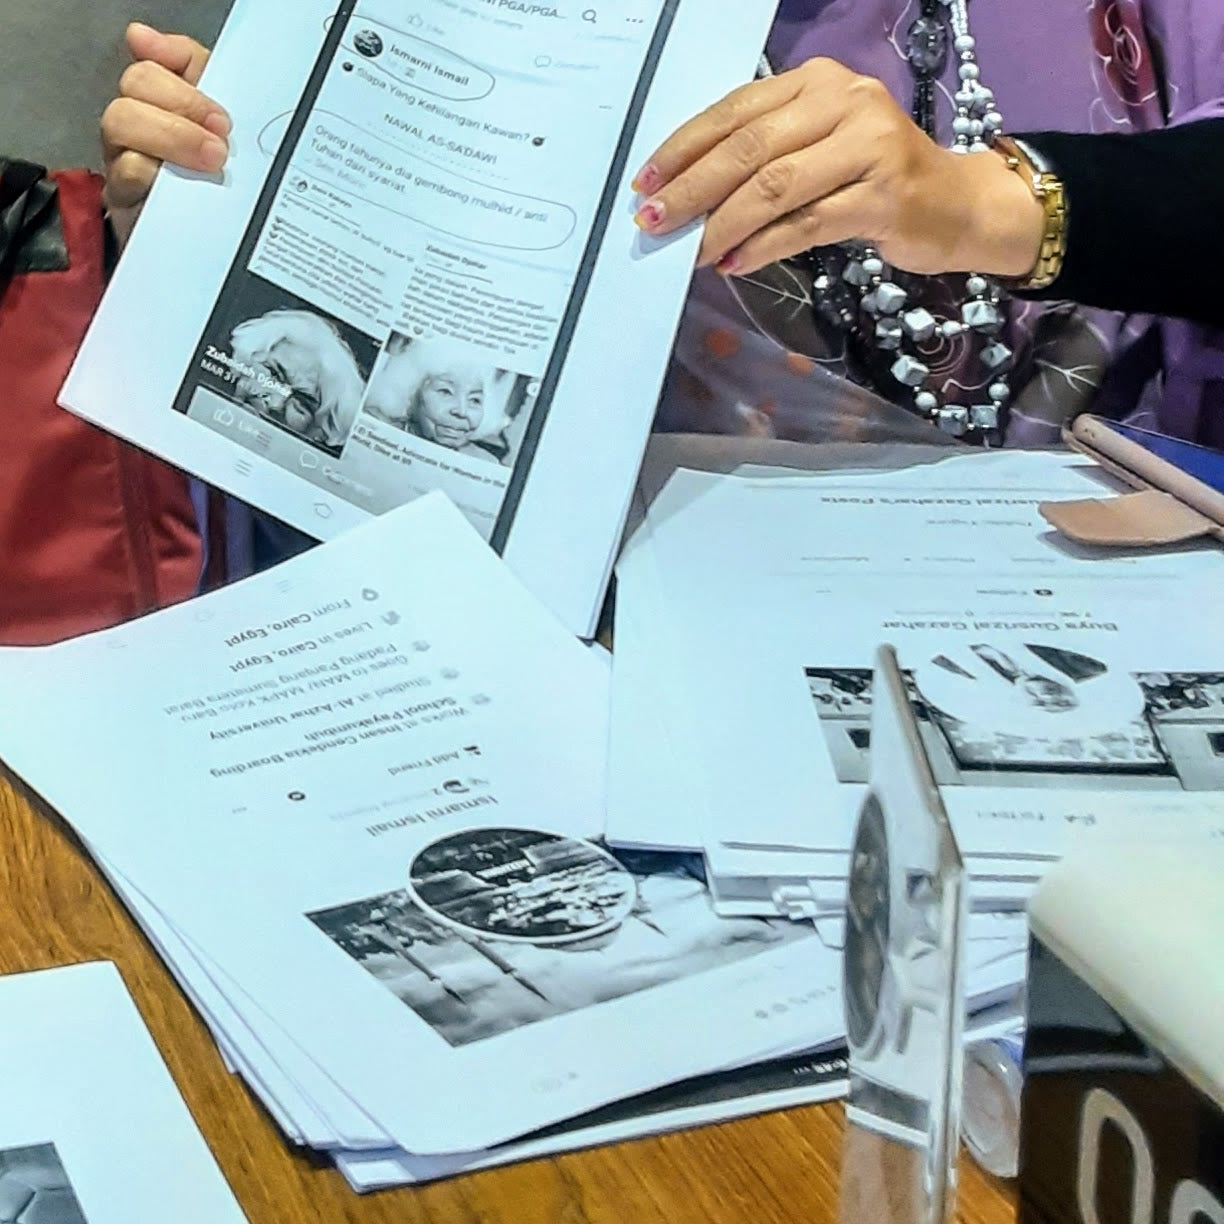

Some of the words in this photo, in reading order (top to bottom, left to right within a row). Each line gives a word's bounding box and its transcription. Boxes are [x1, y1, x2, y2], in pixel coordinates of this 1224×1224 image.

[433, 62, 470, 87] Ismail
[389, 83, 416, 106] Yang
[417, 97, 481, 129] Kehilangan
[483, 122, 530, 142] Kawan?
[384, 113, 424, 138] NAWAL
[311, 139, 343, 162] Tuhan
[315, 124, 348, 149] Orang
[395, 163, 412, 180] dia
[414, 176, 470, 204] gembong
[312, 599, 352, 618] From
[267, 613, 312, 632] Cairo,
[336, 621, 373, 640] Lives
[224, 630, 269, 648] Egypt
[272, 640, 318, 658] Cairo,
[318, 633, 335, 645] in
[229, 655, 274, 673] Egypt
[340, 643, 398, 666] Padang
[374, 677, 432, 700] Studied
[408, 696, 457, 716] School
[209, 715, 288, 742] University
[304, 711, 406, 741] Payakumbuh
[361, 724, 403, 741] Insan
[285, 735, 358, 759] Cendekia
[433, 751, 460, 765] Add
[209, 754, 284, 778] Boarding
[388, 759, 432, 776] Friend
[365, 814, 426, 838] Ismail
